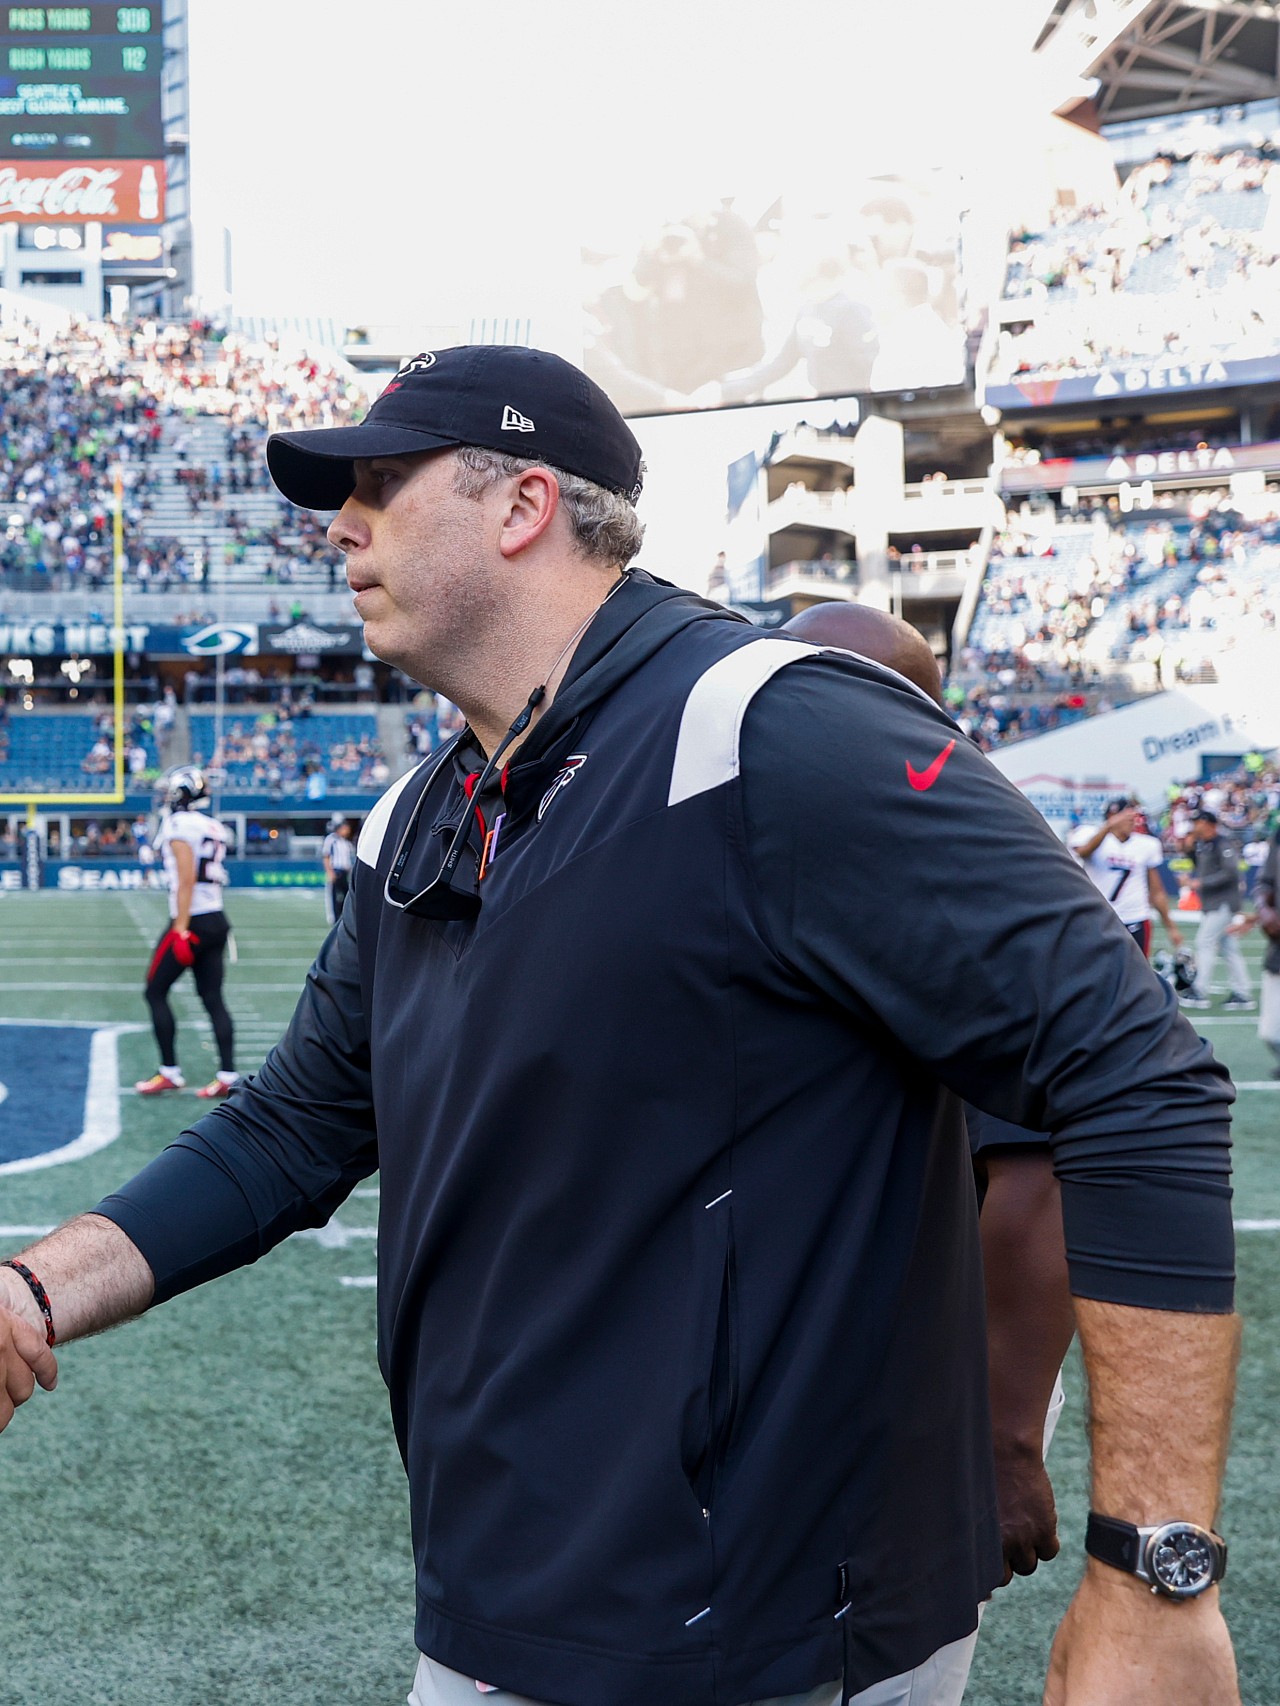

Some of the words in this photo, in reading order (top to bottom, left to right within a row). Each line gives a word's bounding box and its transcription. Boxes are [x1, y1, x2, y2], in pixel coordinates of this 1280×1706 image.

[46, 8, 91, 31] YARDS
[46, 48, 91, 70] YARDS
[1124, 361, 1228, 391] DELTA
[1135, 447, 1235, 476] DELTA
[64, 625, 151, 654] NEST
[1142, 719, 1220, 762] Dream
[1108, 865, 1131, 902] 7
